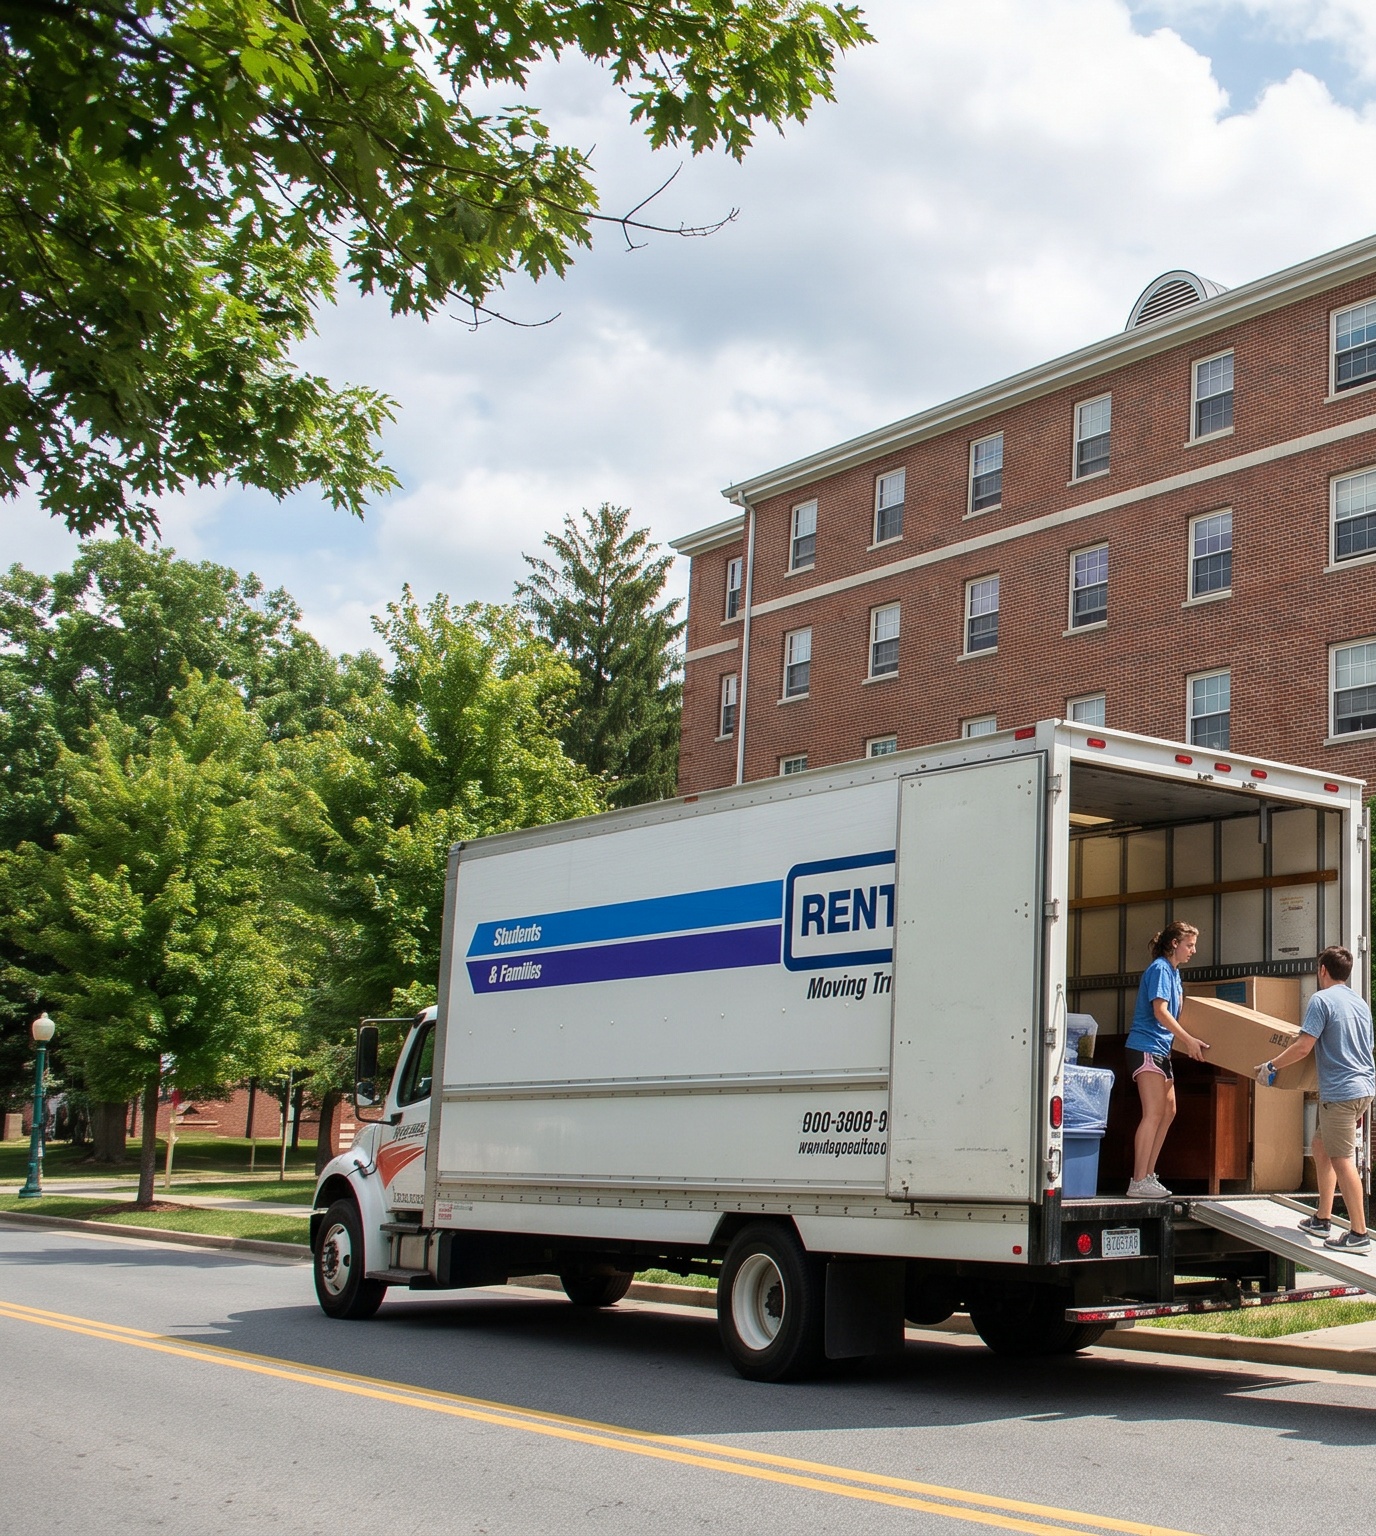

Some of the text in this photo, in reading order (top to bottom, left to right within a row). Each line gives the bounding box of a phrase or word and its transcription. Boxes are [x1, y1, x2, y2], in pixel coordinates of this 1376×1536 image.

[801, 884, 895, 937] RENT
[493, 923, 542, 947] Students
[488, 965, 498, 984] &
[807, 975, 868, 1001] Moving
